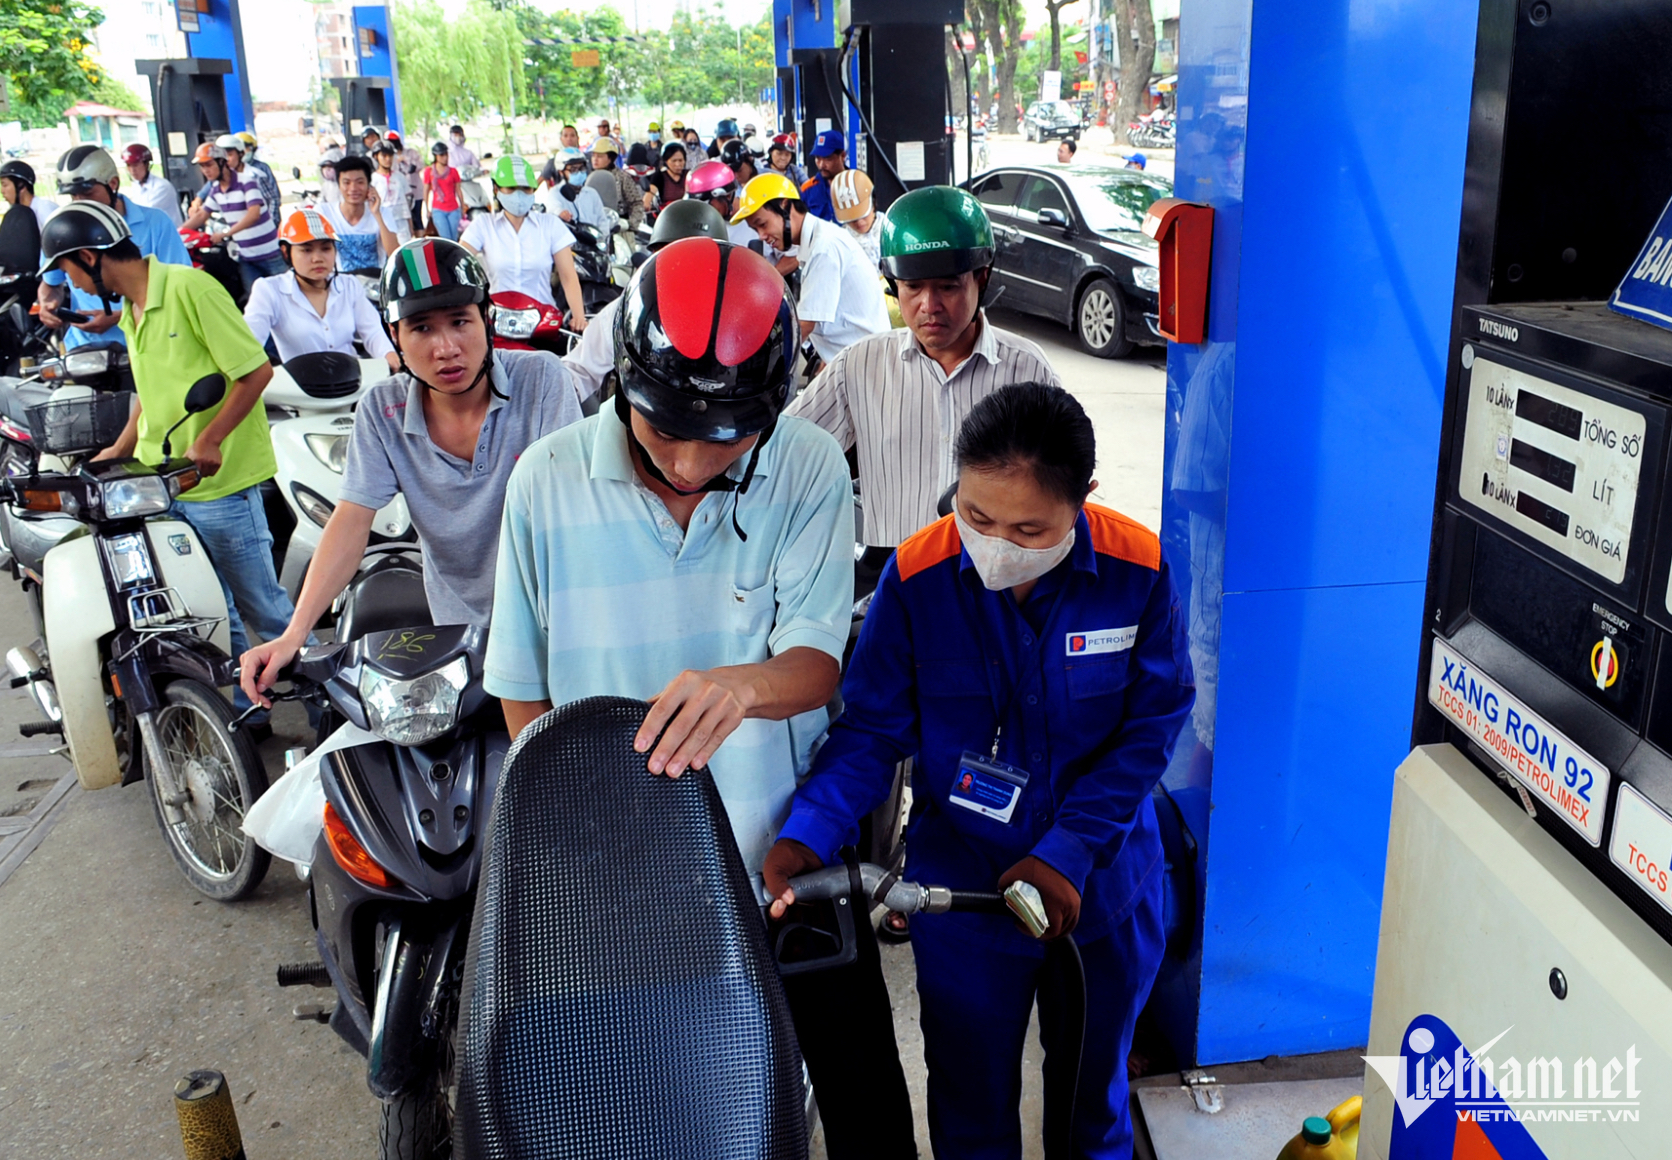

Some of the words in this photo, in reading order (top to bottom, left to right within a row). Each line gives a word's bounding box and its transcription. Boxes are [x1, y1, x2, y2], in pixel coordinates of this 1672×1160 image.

[905, 241, 950, 252] HONDA
[1478, 317, 1519, 343] TATSUNO
[1486, 385, 1494, 403] 10
[1583, 418, 1617, 449] TỔNG
[1621, 435, 1642, 458] SỐ
[1592, 478, 1615, 506] LÍT
[1574, 525, 1600, 550] ĐƠN
[1601, 538, 1622, 561] GIÁ
[1435, 608, 1441, 622] 2
[1592, 602, 1630, 631] EMERGENCY
[1601, 621, 1618, 636] STOP
[1088, 633, 1136, 646] PETROLIM
[1440, 656, 1499, 724] XĂNG
[1505, 707, 1558, 773] RON
[1563, 757, 1594, 804] 92
[1438, 684, 1464, 719] TCCS
[1483, 723, 1590, 828] 2009/PETROLIMEX
[1628, 842, 1668, 893] TCCS
